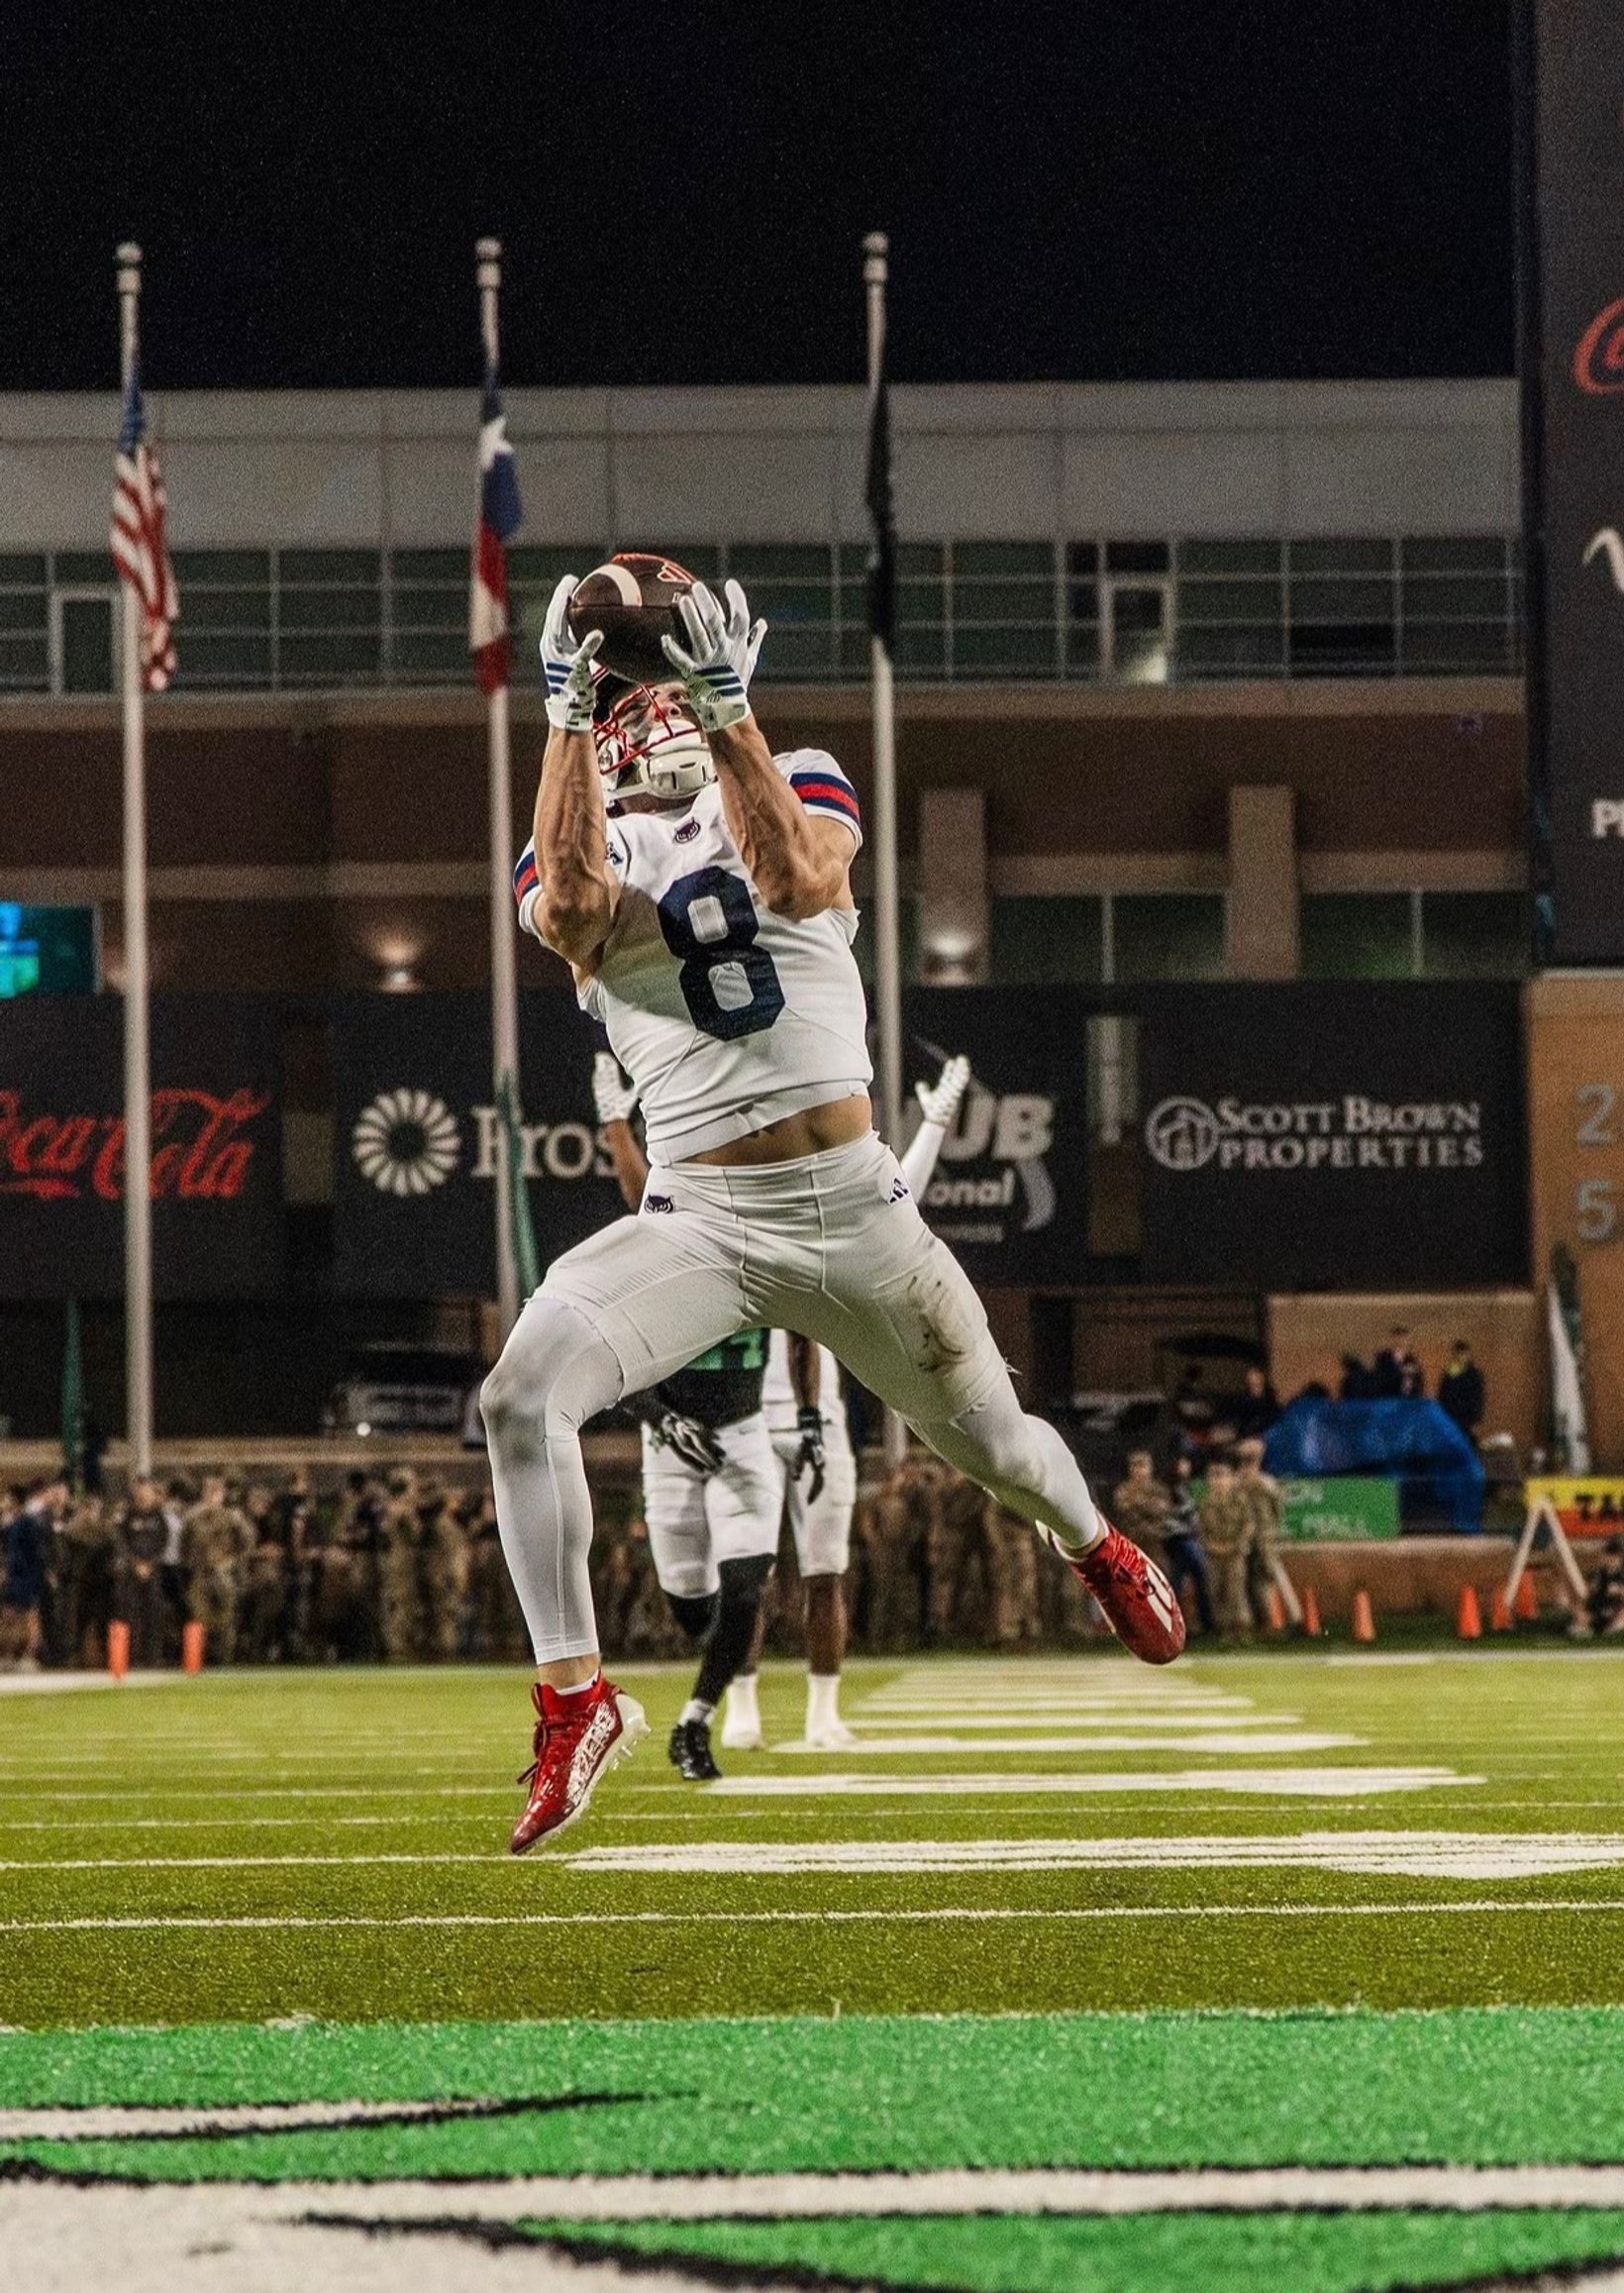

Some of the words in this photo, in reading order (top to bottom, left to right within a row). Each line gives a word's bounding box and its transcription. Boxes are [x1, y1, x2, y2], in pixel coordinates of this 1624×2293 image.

[658, 866, 785, 1041] 8
[1219, 1137, 1483, 1170] PROPERTIES
[1575, 1493, 1624, 1521] TA
